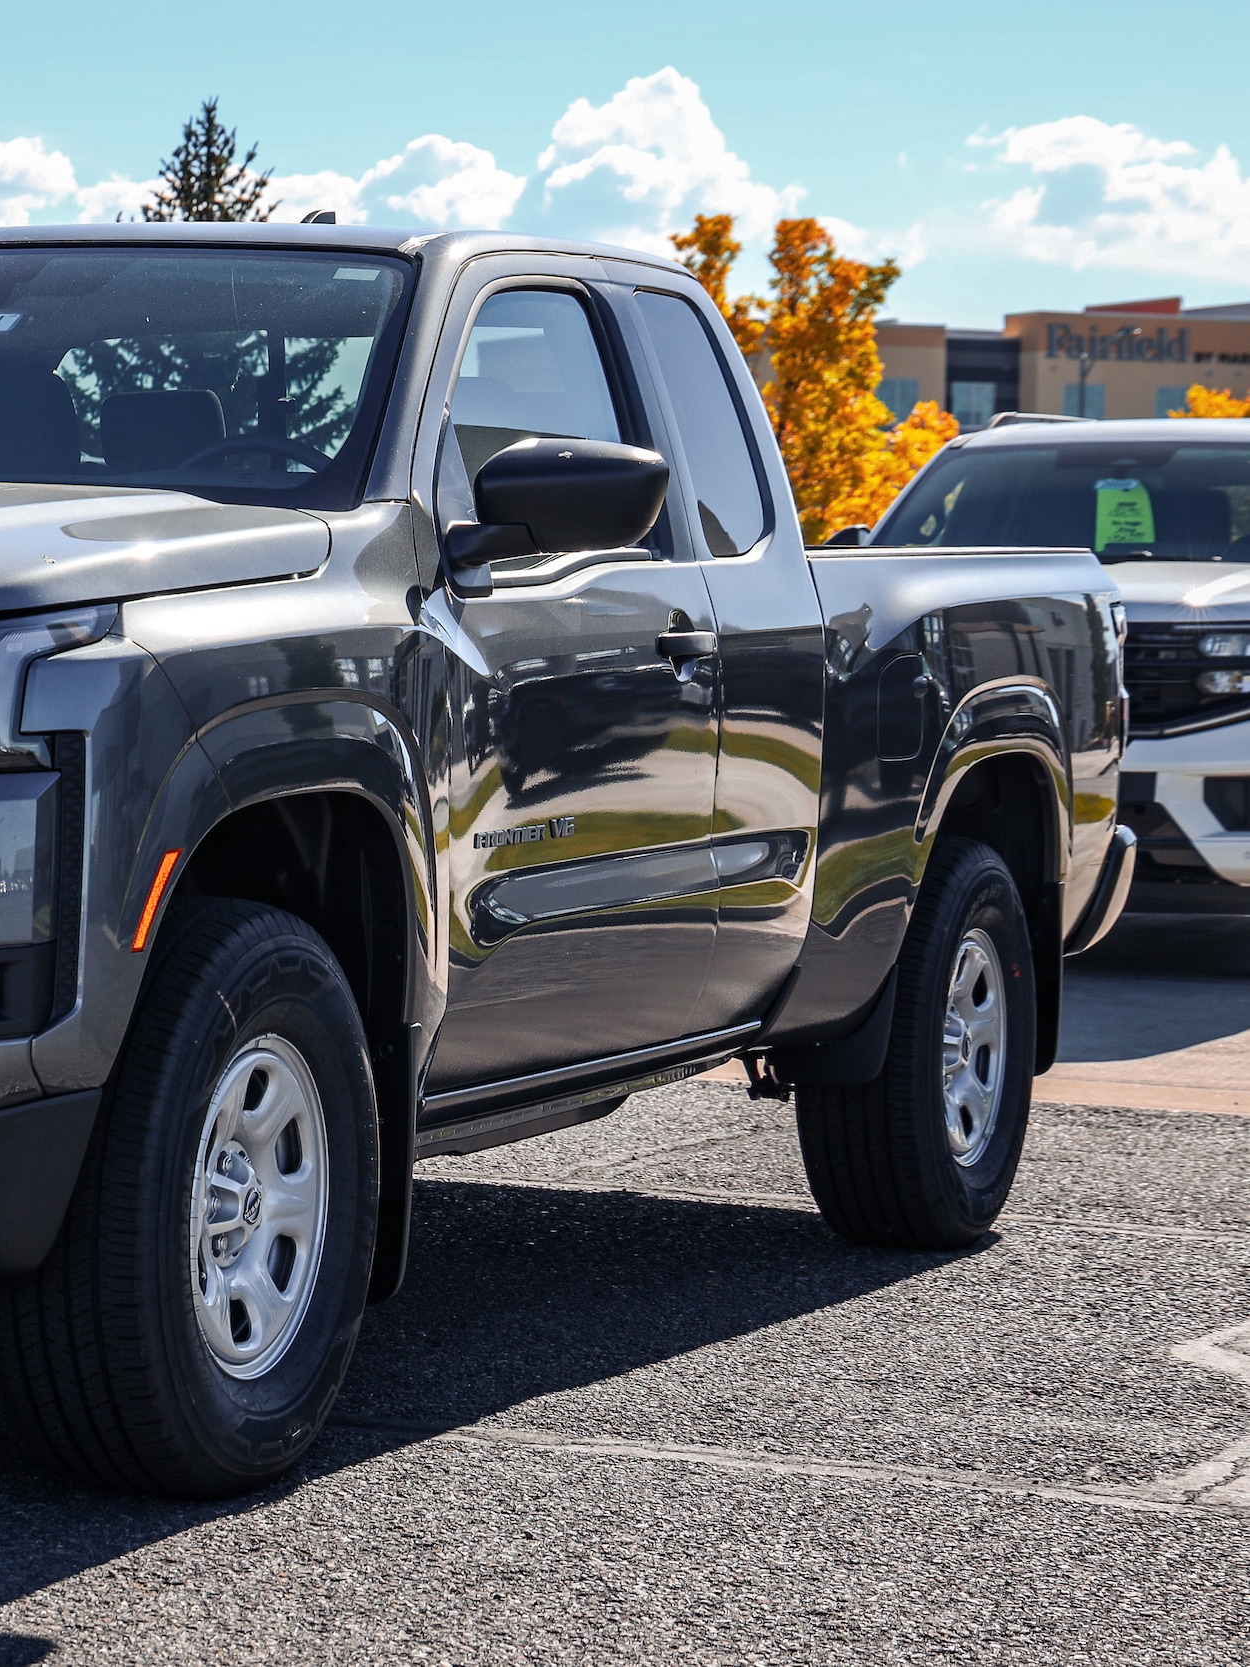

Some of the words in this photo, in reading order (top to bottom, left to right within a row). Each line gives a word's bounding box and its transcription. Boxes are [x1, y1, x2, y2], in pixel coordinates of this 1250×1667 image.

[1045, 321, 1190, 363] Fairfield
[473, 824, 547, 849] FRONTIER
[549, 816, 575, 839] V6
